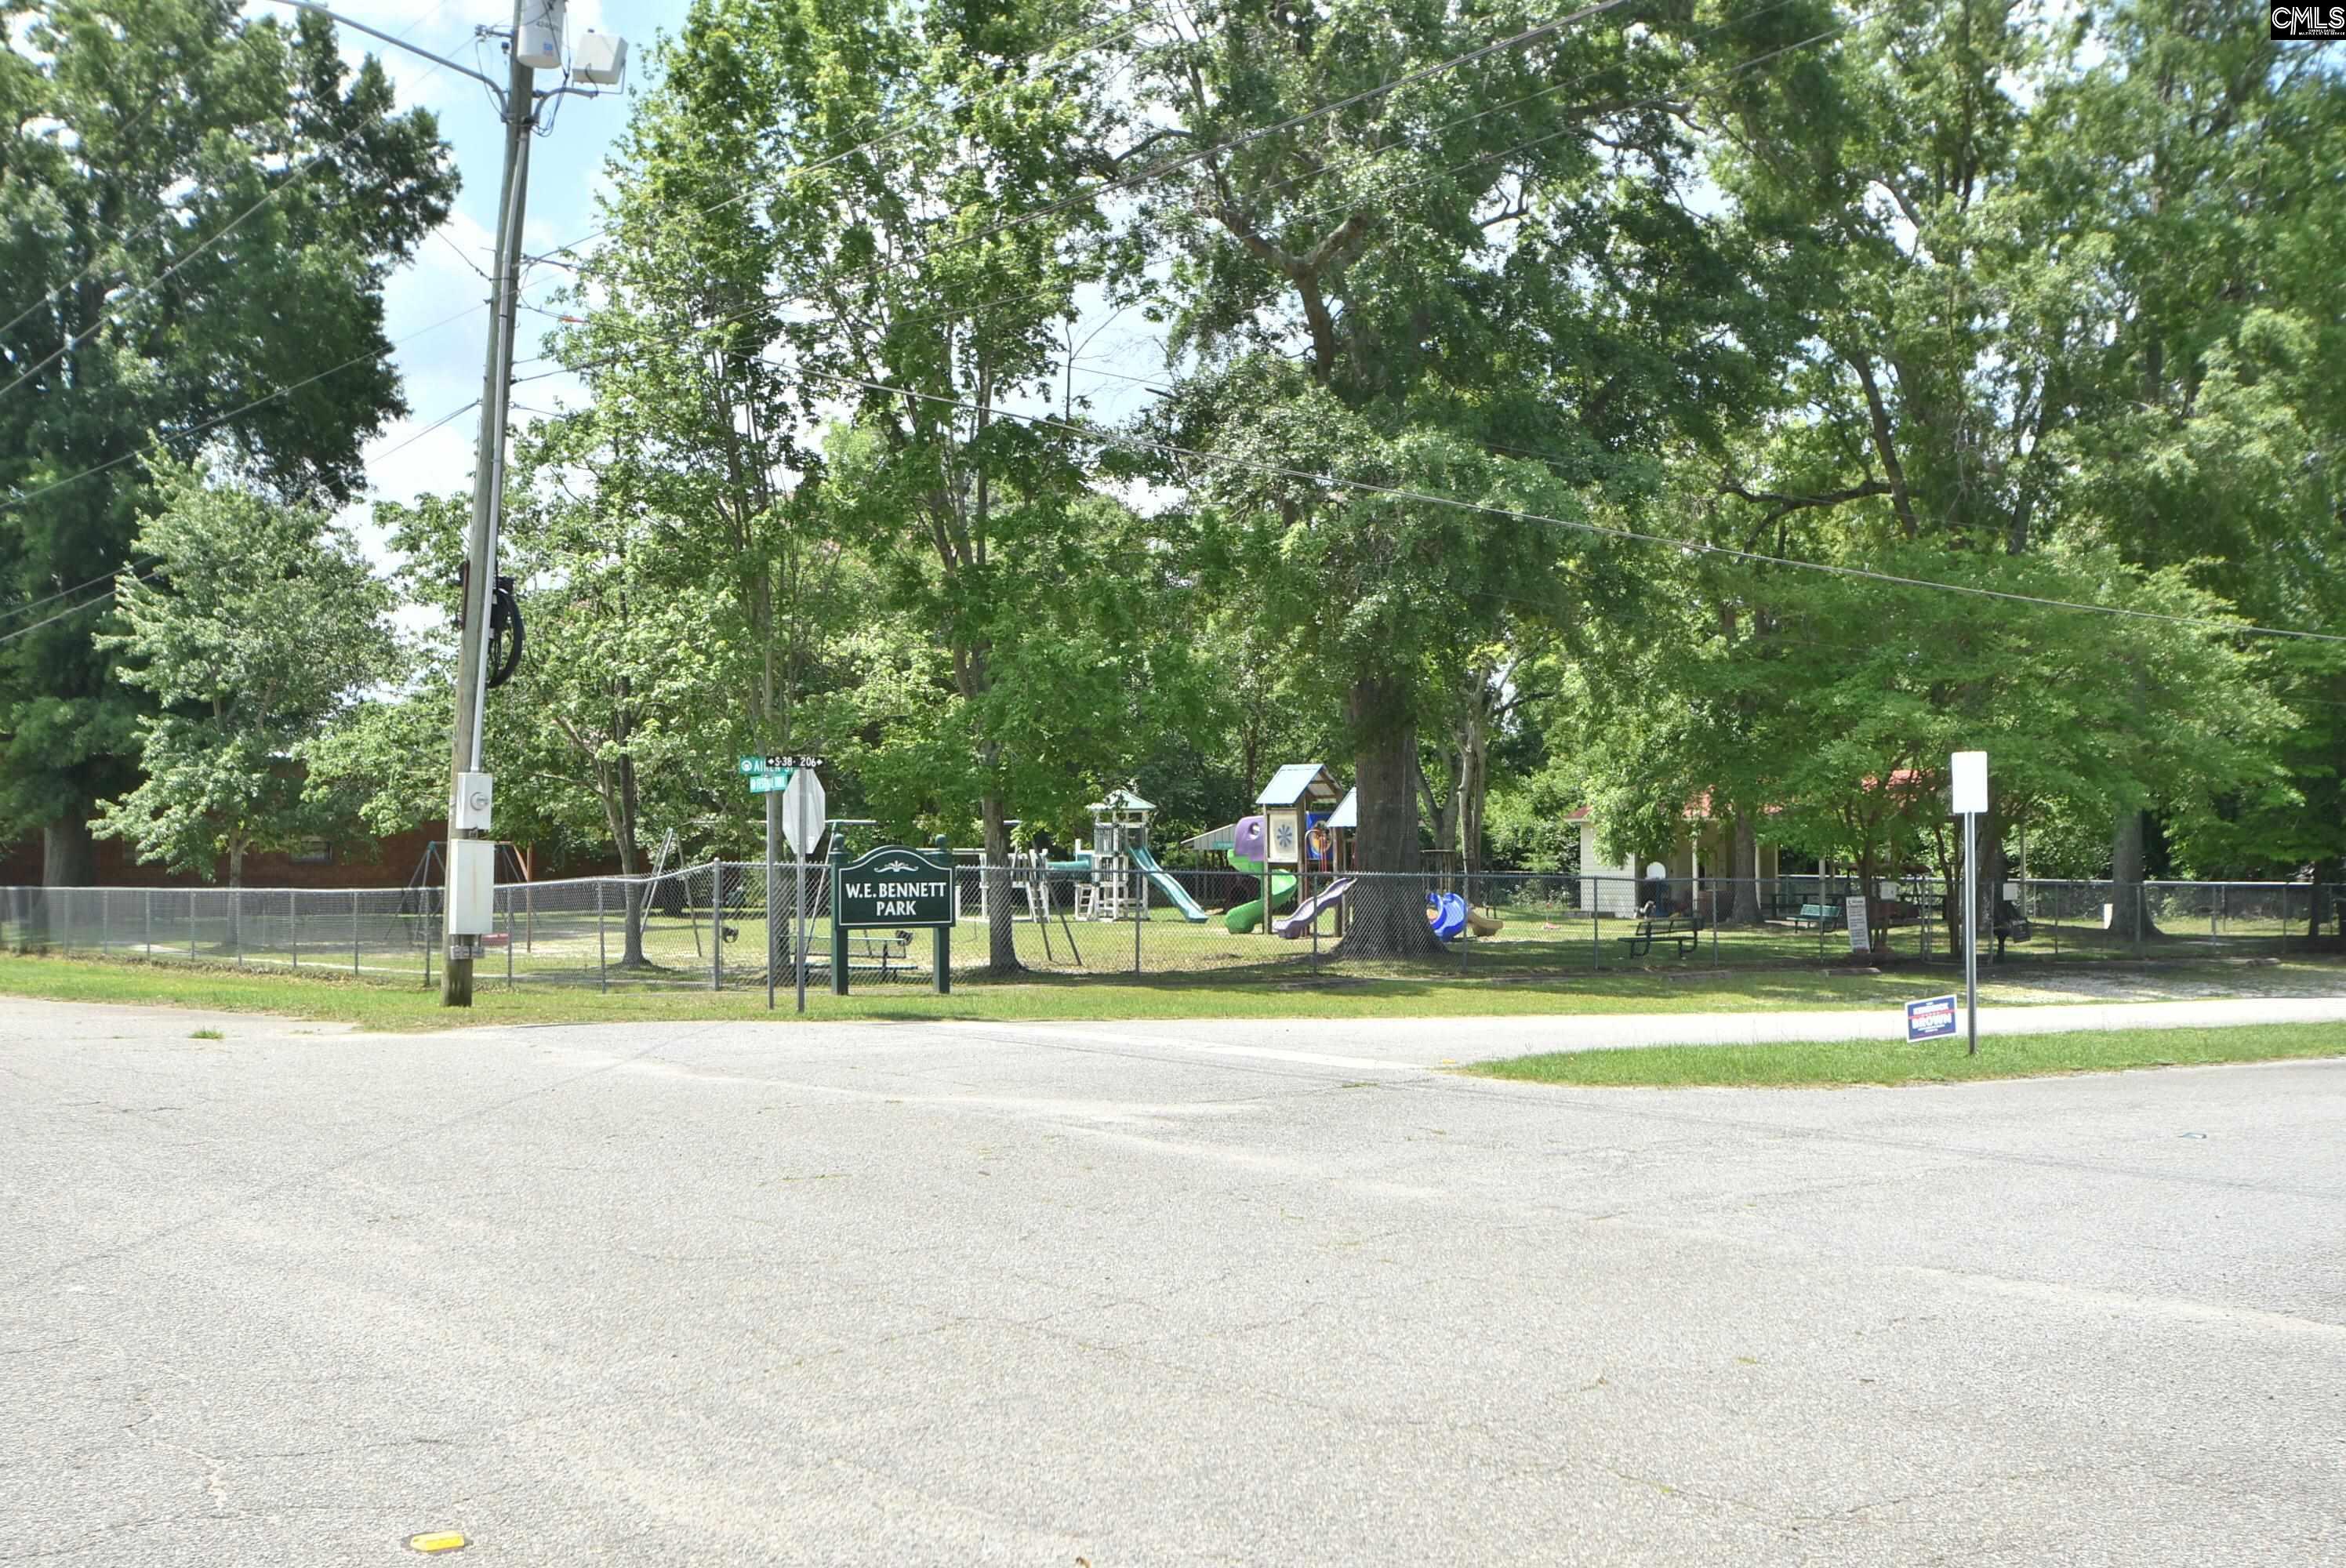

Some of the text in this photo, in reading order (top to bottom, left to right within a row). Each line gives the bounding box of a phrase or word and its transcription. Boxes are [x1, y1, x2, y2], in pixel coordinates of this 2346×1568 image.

[800, 757, 816, 767] 206
[845, 882, 946, 898] W.E. BENNETT
[876, 900, 917, 916] PARK
